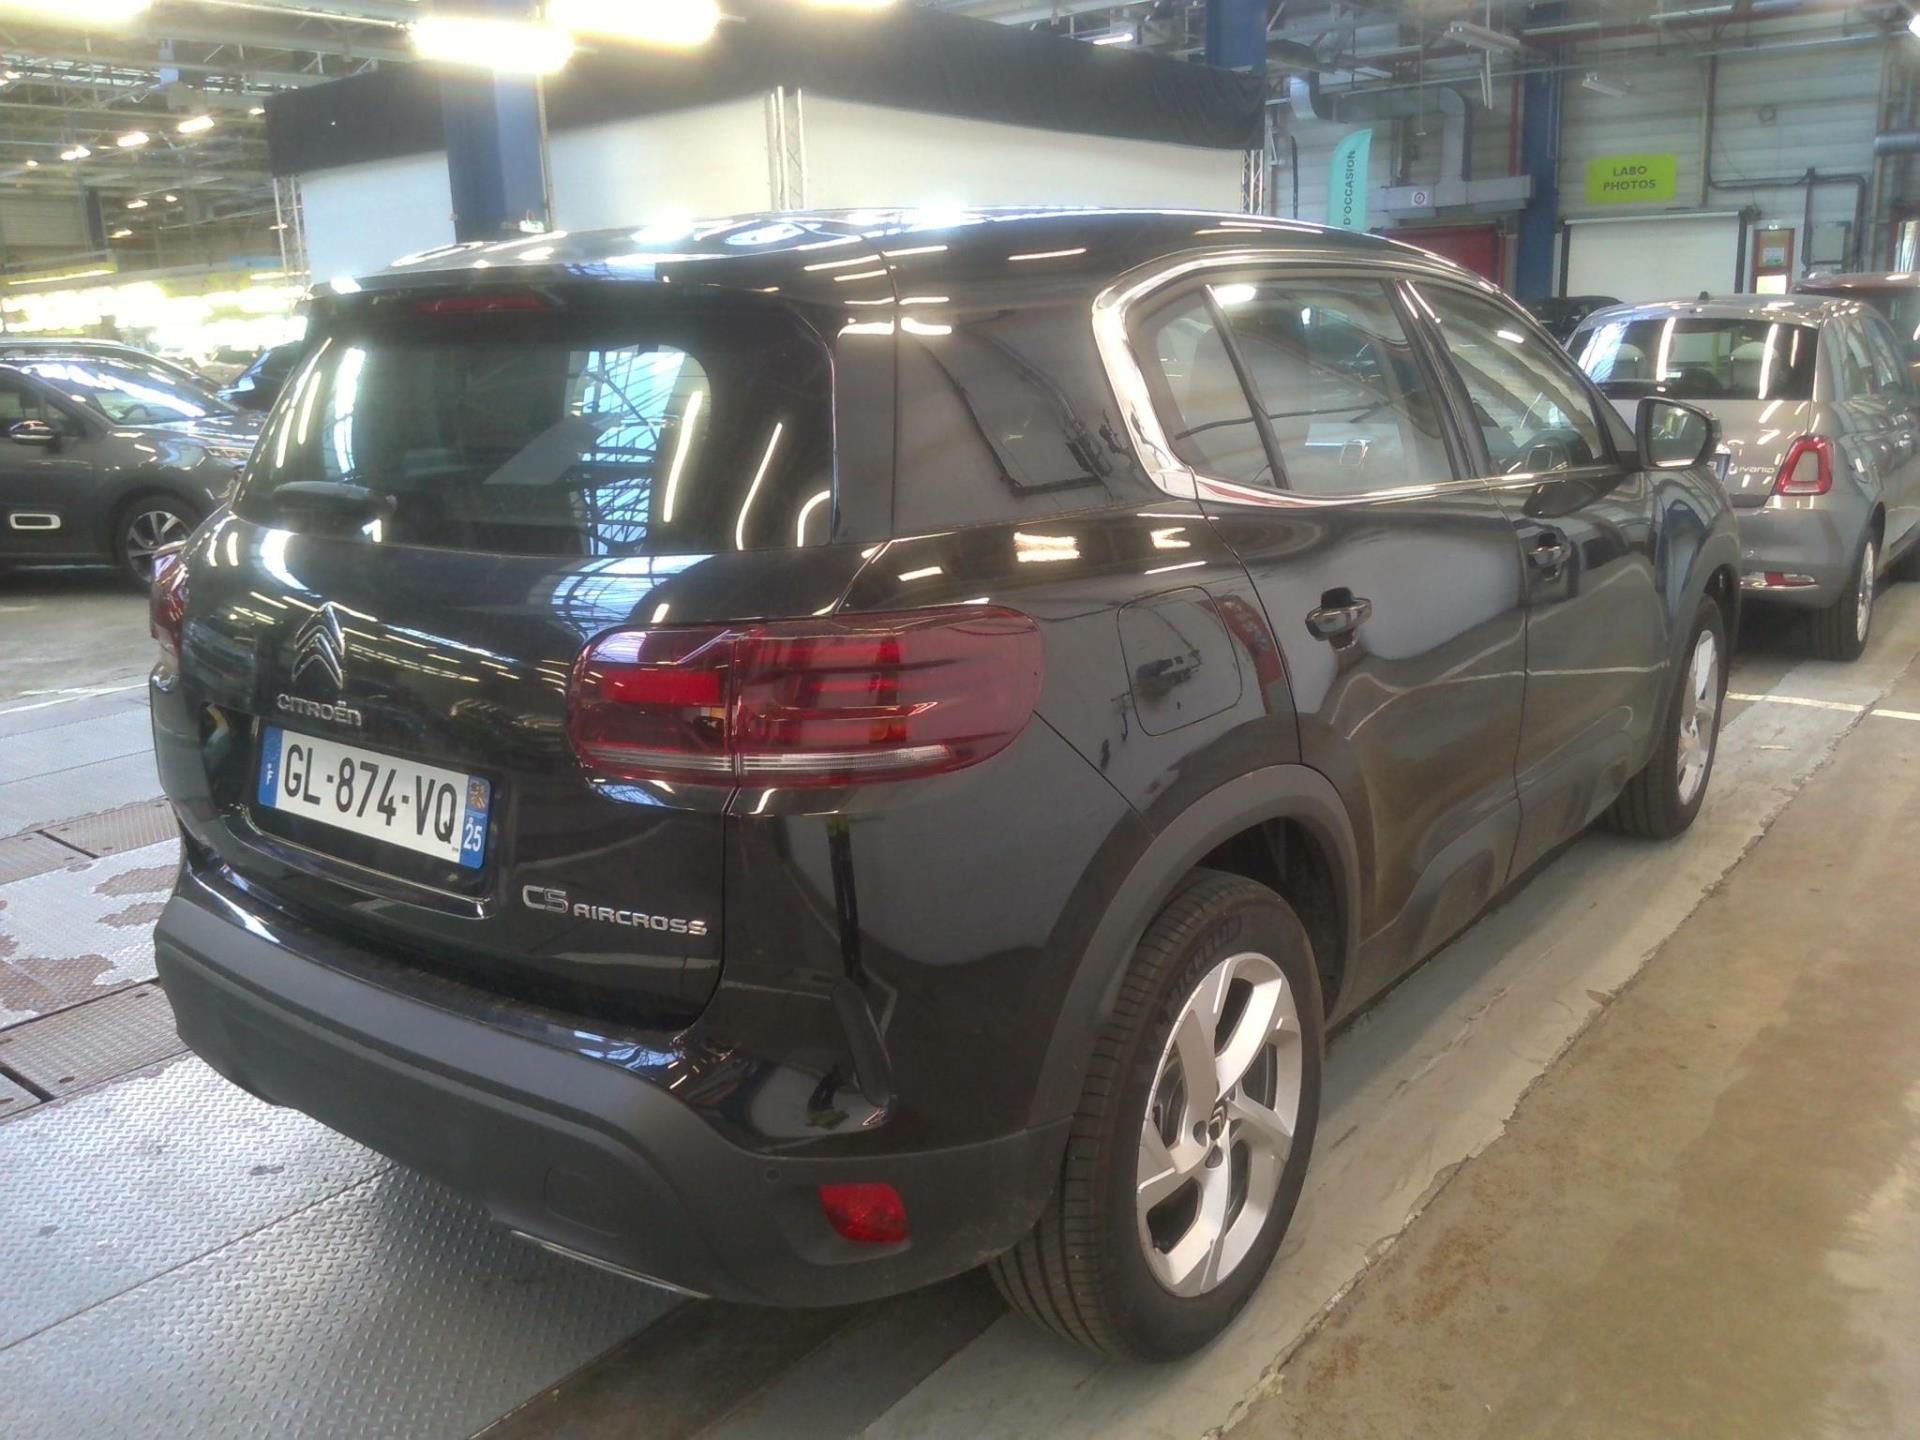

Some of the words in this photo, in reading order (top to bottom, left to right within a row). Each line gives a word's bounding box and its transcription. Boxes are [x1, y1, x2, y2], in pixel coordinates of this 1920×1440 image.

[1343, 150, 1356, 226] D'OCCASION
[1602, 179, 1656, 192] PHOTOS
[1612, 165, 1648, 177] LABO
[284, 743, 458, 845] GL-874-VQ
[463, 823, 483, 853] 25
[522, 884, 569, 914] C5
[573, 903, 708, 936] AIRCROSS
